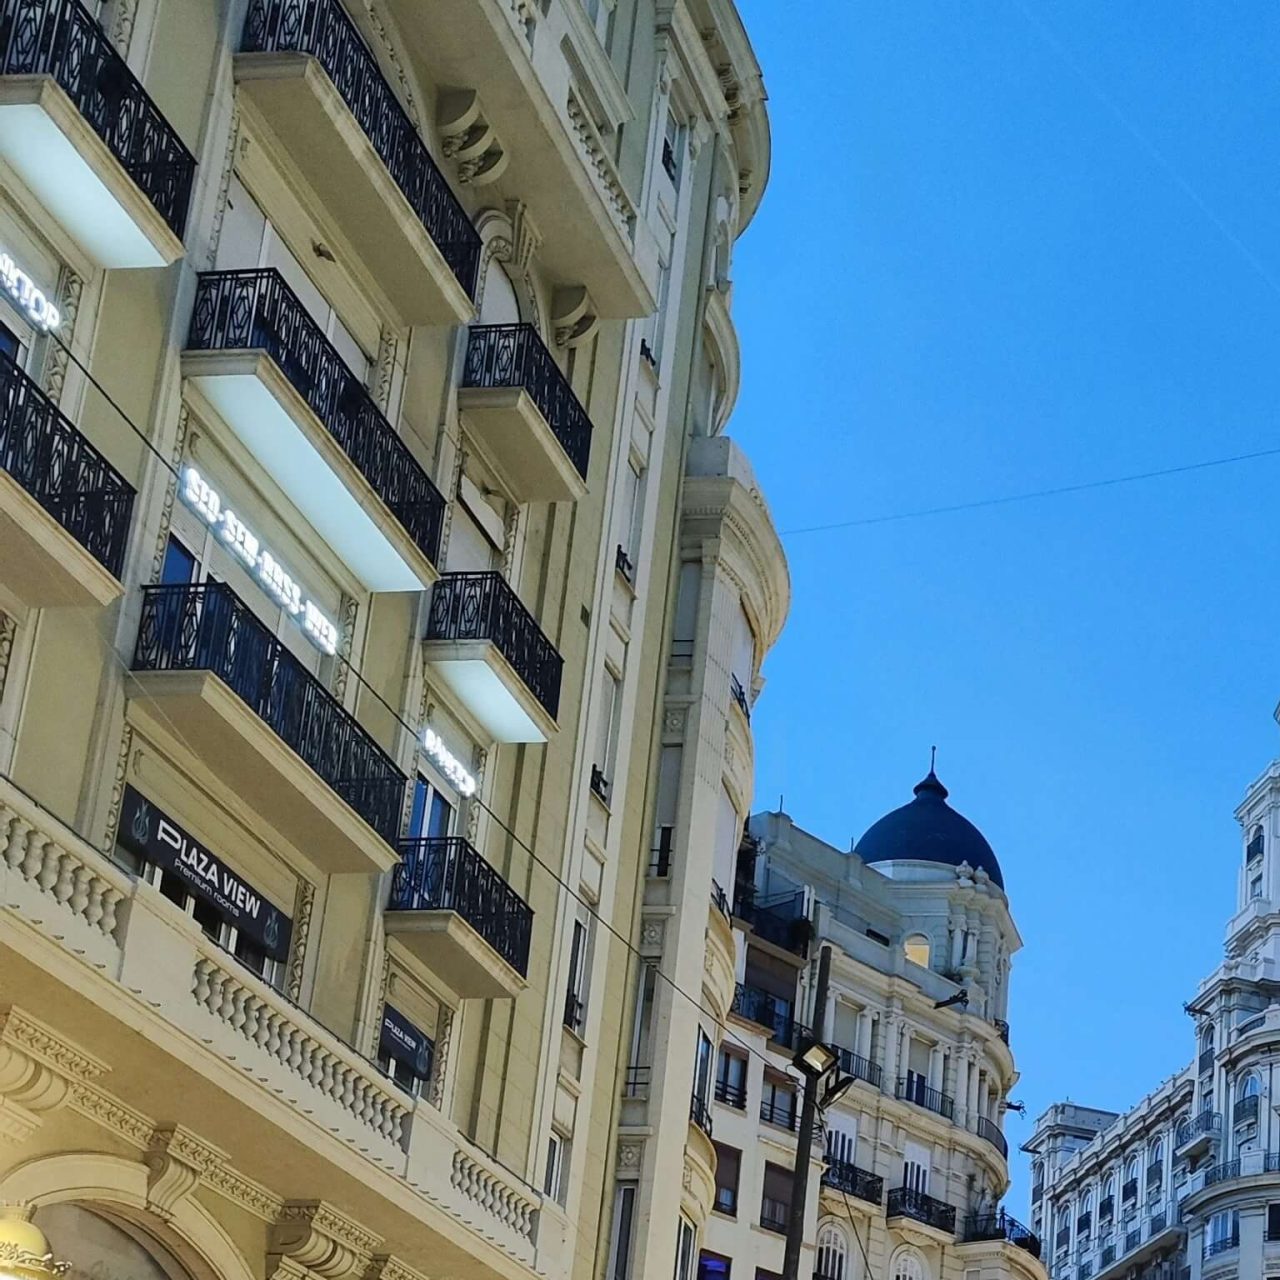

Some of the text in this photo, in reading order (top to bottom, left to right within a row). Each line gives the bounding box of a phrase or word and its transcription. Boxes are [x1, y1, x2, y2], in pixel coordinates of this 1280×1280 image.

[157, 819, 260, 919] PLAZA VIEW
[174, 858, 239, 917] Premium rooms
